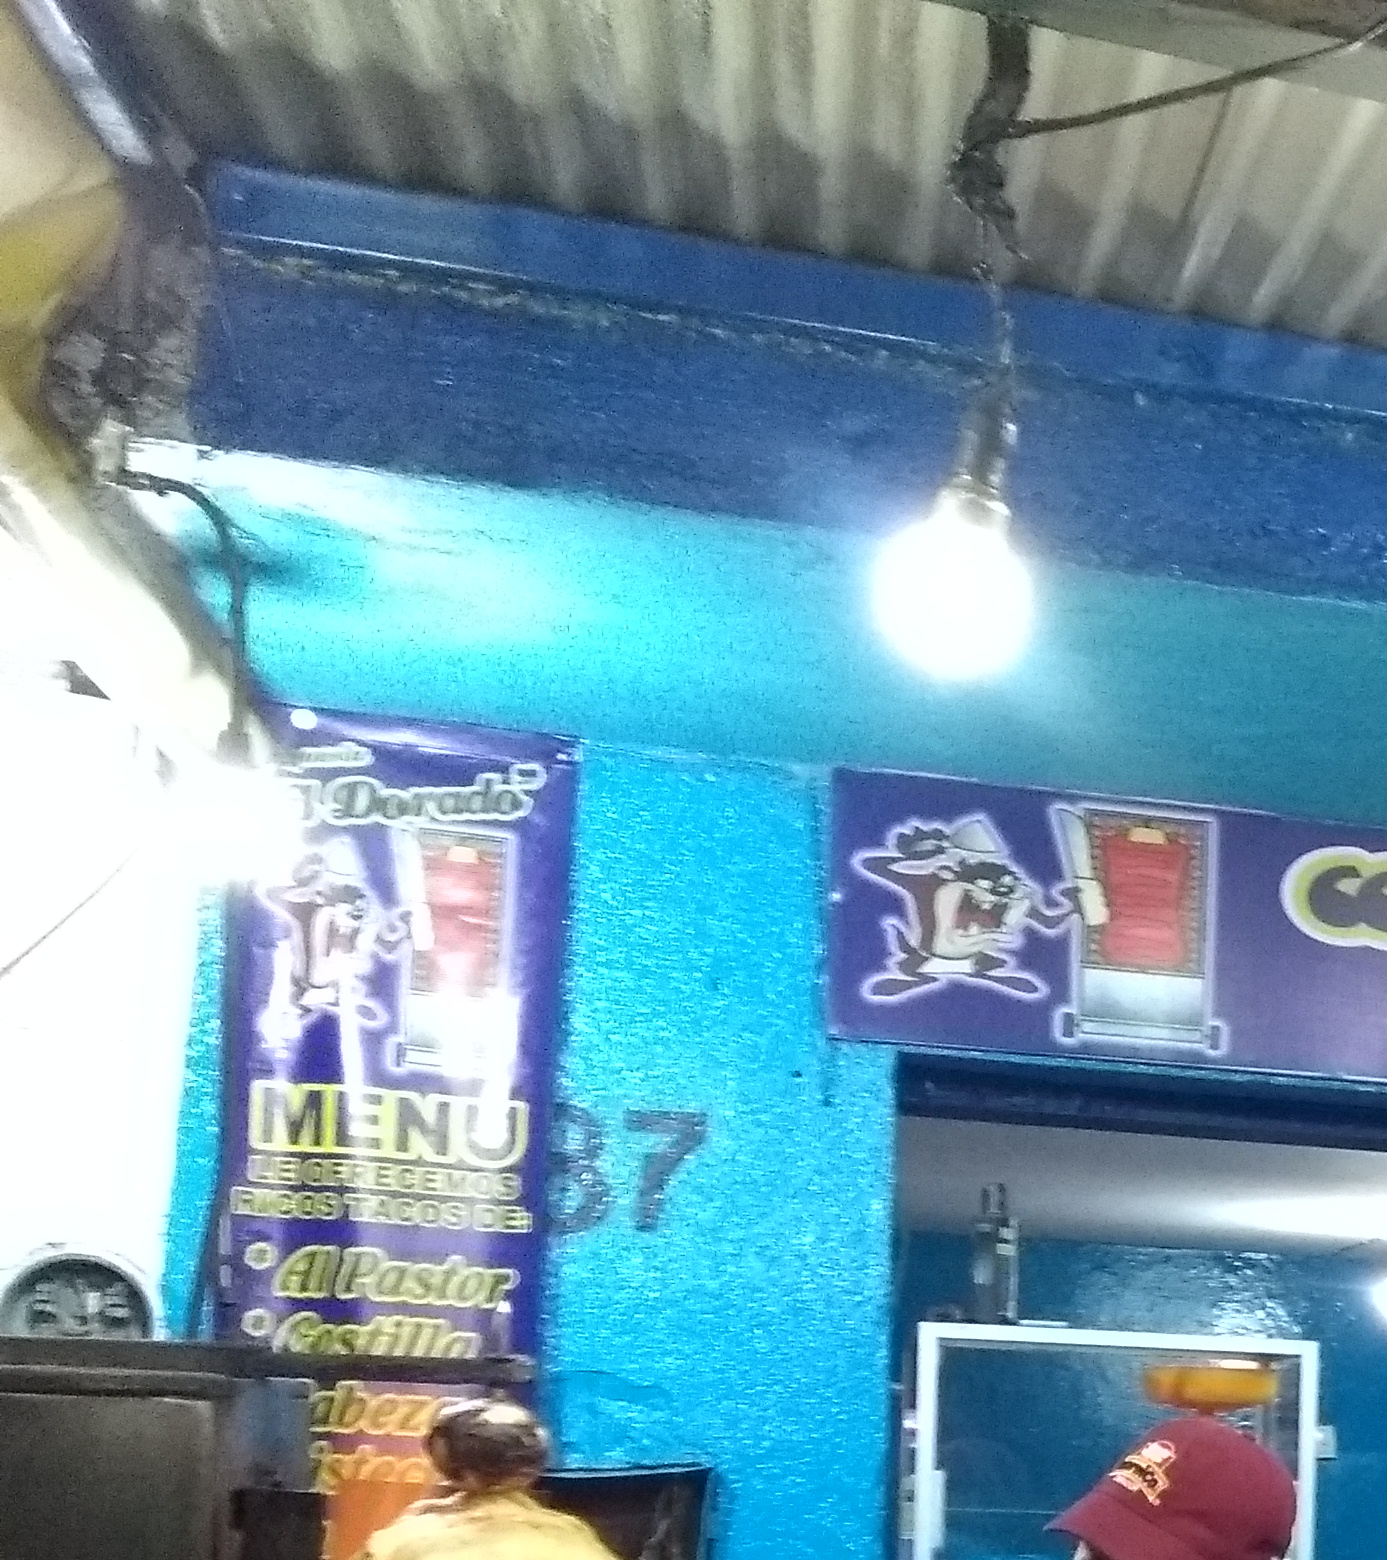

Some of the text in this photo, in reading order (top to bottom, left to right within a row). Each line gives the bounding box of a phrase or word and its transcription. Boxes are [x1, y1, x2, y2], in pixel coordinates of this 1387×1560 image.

[249, 1080, 529, 1168] MENU
[344, 1194, 472, 1230] TACOS
[273, 1245, 521, 1309] Al Pastor
